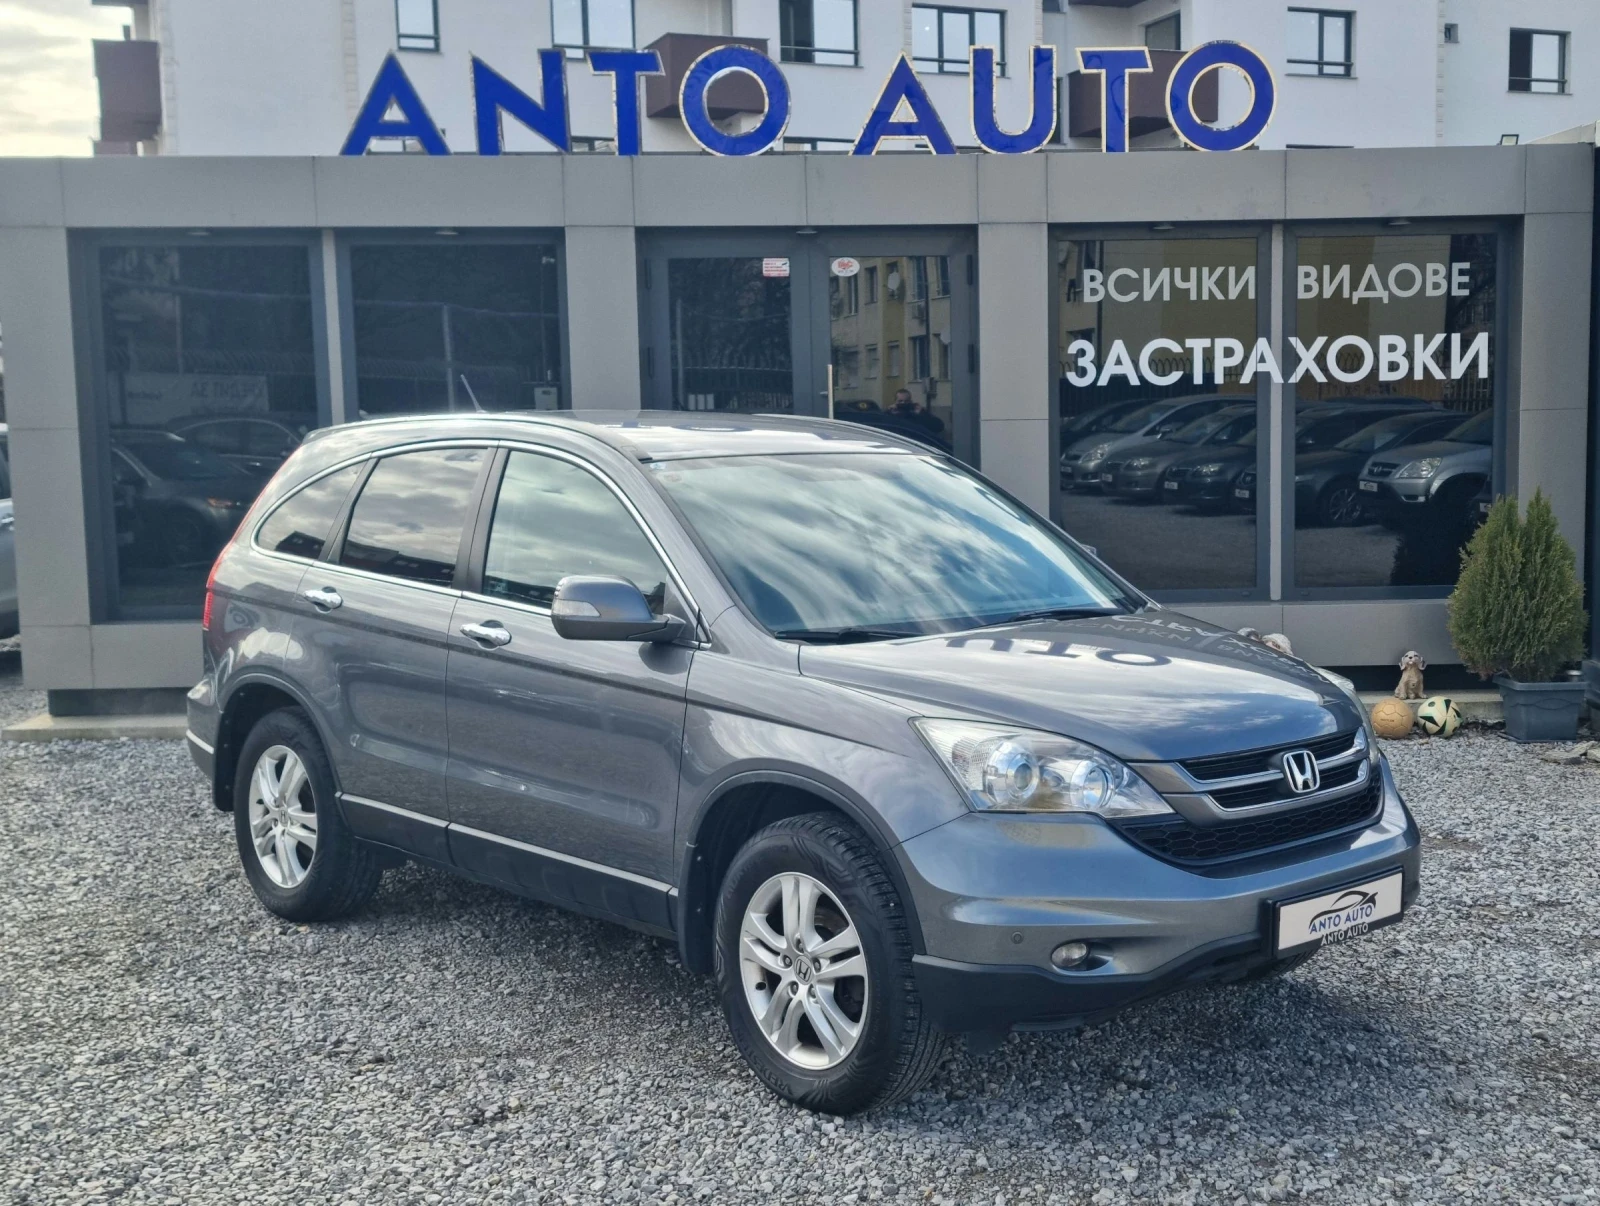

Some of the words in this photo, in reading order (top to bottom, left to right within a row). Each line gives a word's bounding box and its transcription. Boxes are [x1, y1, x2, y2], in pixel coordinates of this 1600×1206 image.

[339, 43, 792, 156] ANTO
[848, 40, 1278, 155] AUTO
[1083, 265, 1256, 302] ВСИЧКИ
[1297, 262, 1470, 304] ВИДОВЕ
[1066, 332, 1489, 387] ЗАСТРАХОВКИ
[1309, 914, 1342, 935] ANTO
[1344, 904, 1373, 924] AUTO
[1320, 930, 1345, 946] ANTO
[1346, 922, 1369, 939] AUTO
